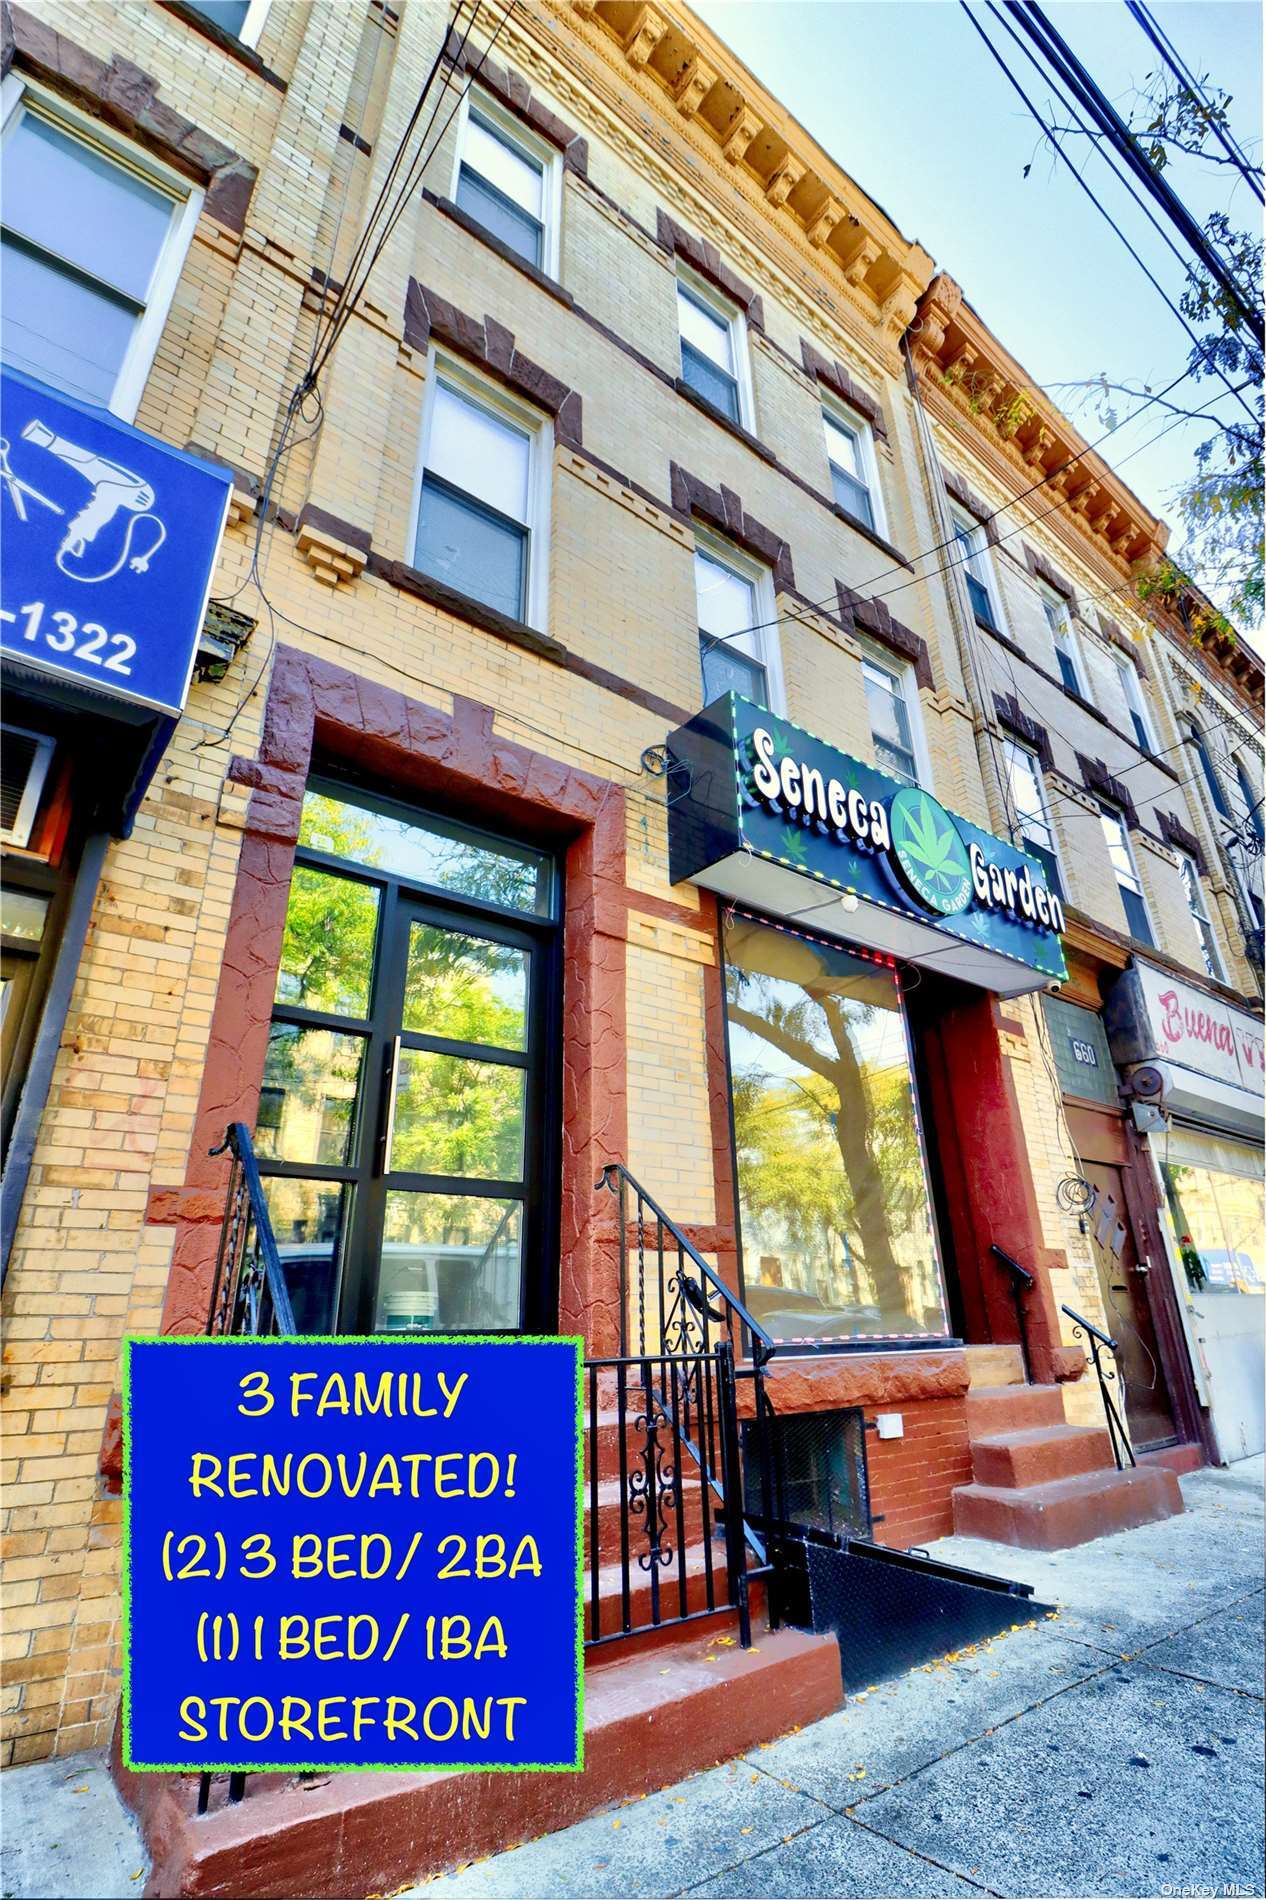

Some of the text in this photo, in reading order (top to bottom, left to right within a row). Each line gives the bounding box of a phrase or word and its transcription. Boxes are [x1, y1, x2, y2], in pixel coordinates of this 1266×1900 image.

[753, 727, 1066, 934] Seneca Garden
[898, 849, 971, 912] SENECA GARDEN
[1073, 1040, 1096, 1065] 660
[1158, 990, 1234, 1057] Buena
